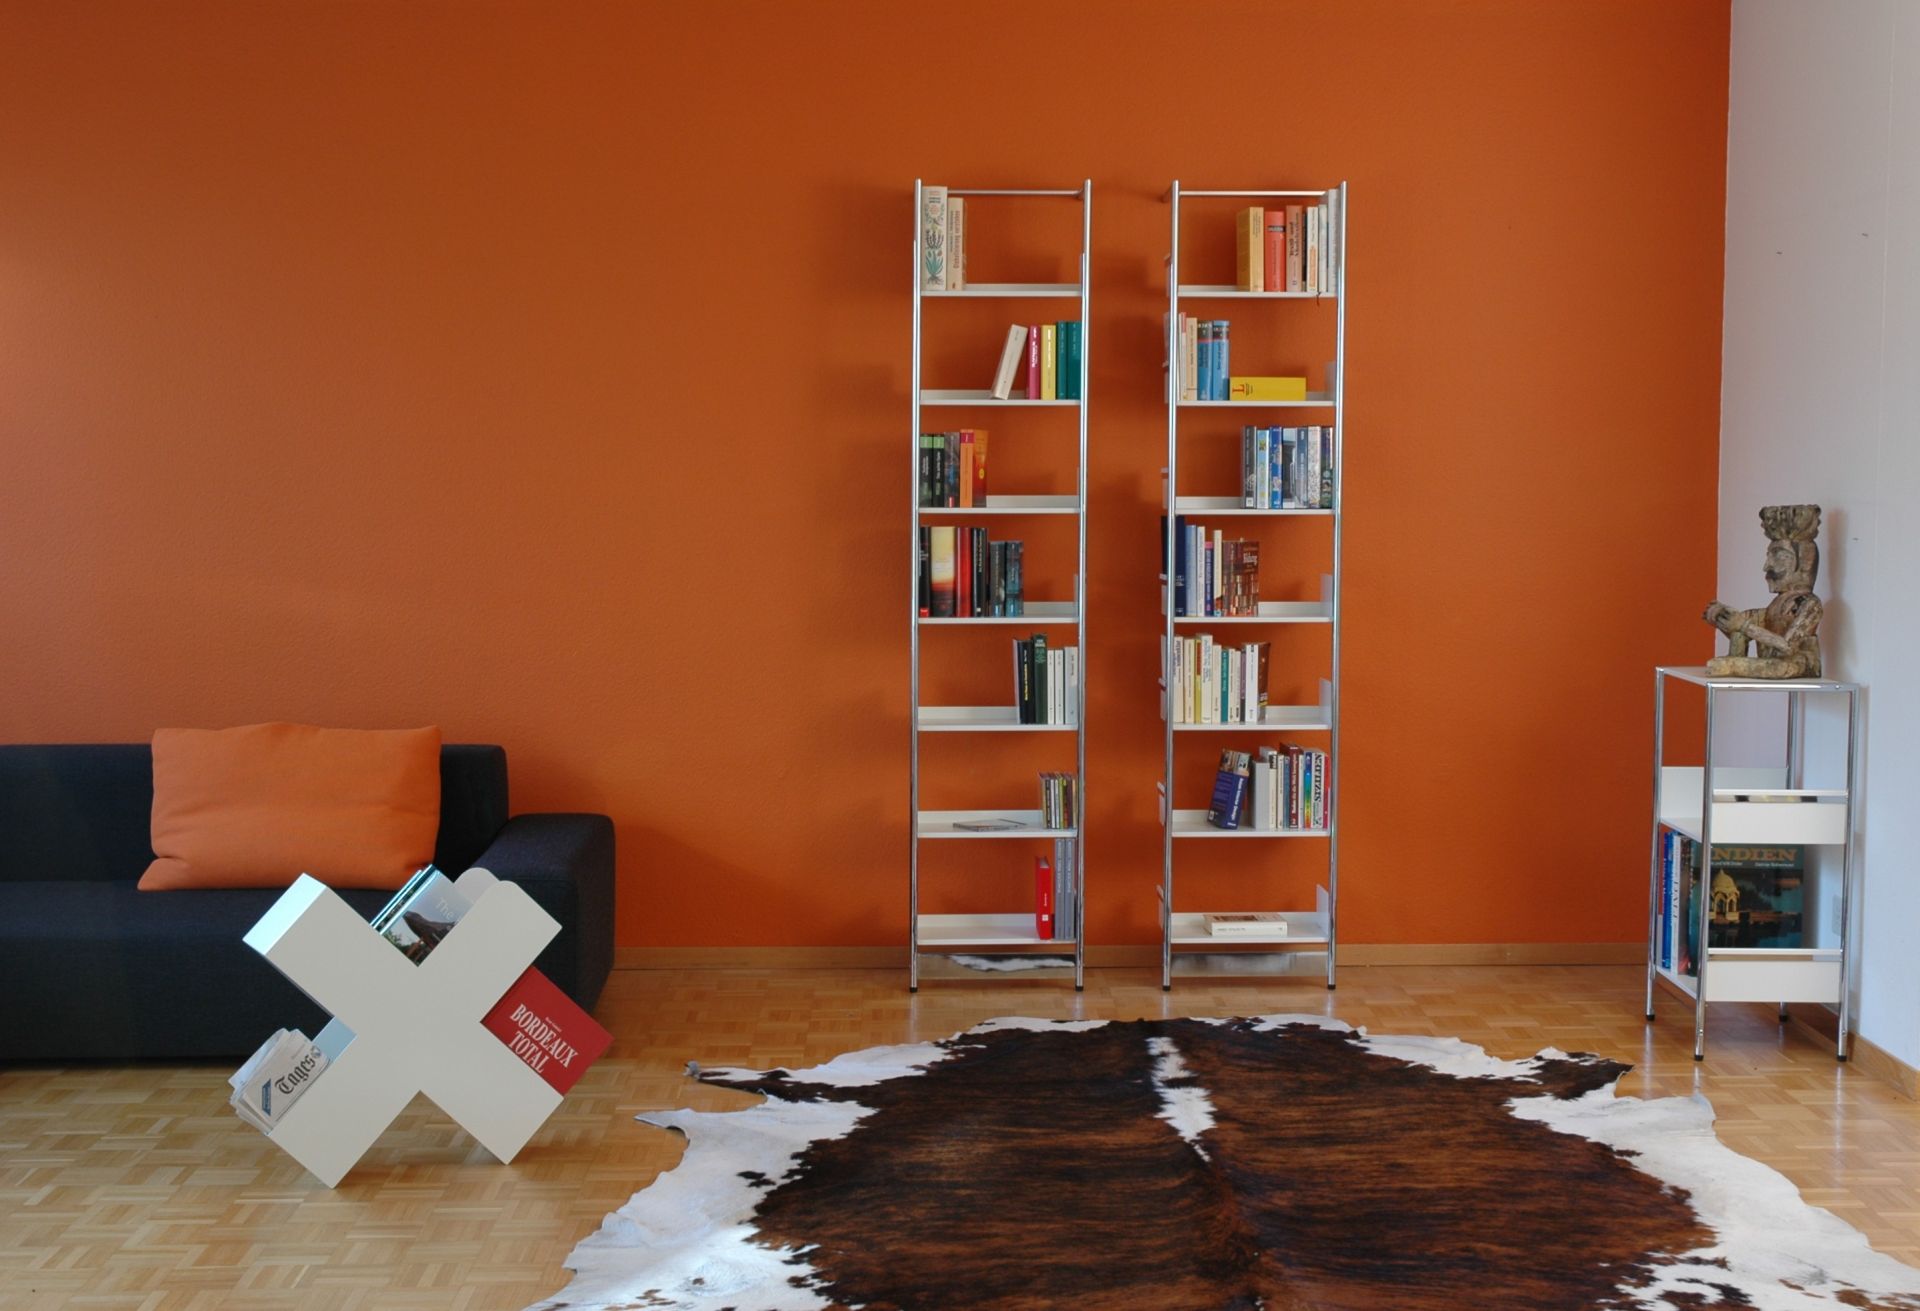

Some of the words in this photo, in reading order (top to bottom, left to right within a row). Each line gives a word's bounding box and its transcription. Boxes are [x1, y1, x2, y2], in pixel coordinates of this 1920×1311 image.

[1711, 848, 1797, 861] NDIEN
[435, 896, 455, 920] The
[509, 1030, 550, 1073] TOTAL
[510, 1003, 578, 1068] BORDEAUX
[274, 1054, 316, 1095] Tages
